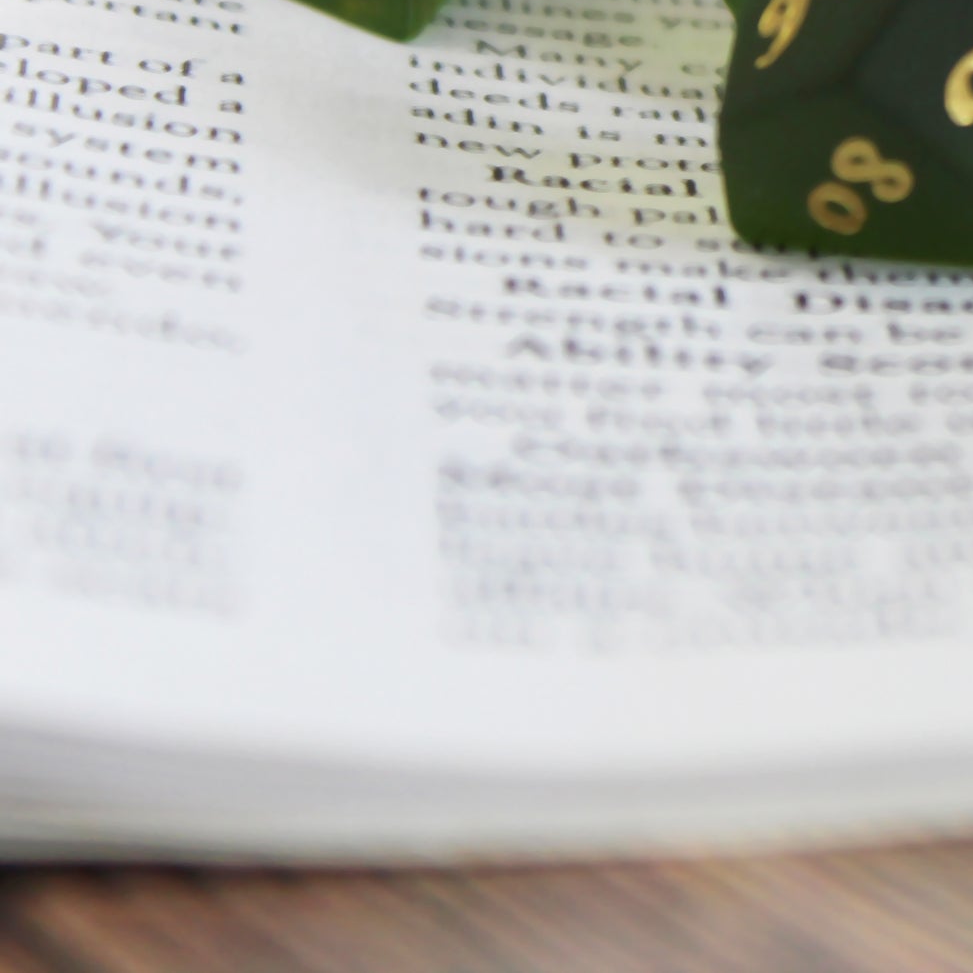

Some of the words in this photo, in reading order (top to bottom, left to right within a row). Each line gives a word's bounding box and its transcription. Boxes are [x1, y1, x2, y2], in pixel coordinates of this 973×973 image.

[138, 56, 208, 80] of
[219, 71, 245, 87] a
[474, 39, 645, 75] Many
[0, 57, 188, 108] loped
[218, 99, 244, 115] a
[407, 76, 581, 114] deeds
[413, 130, 544, 160] new
[485, 163, 704, 200] Racial
[806, 135, 915, 236] 80
[415, 187, 604, 220] tough
[419, 208, 565, 243] hard
[601, 230, 667, 250] to
